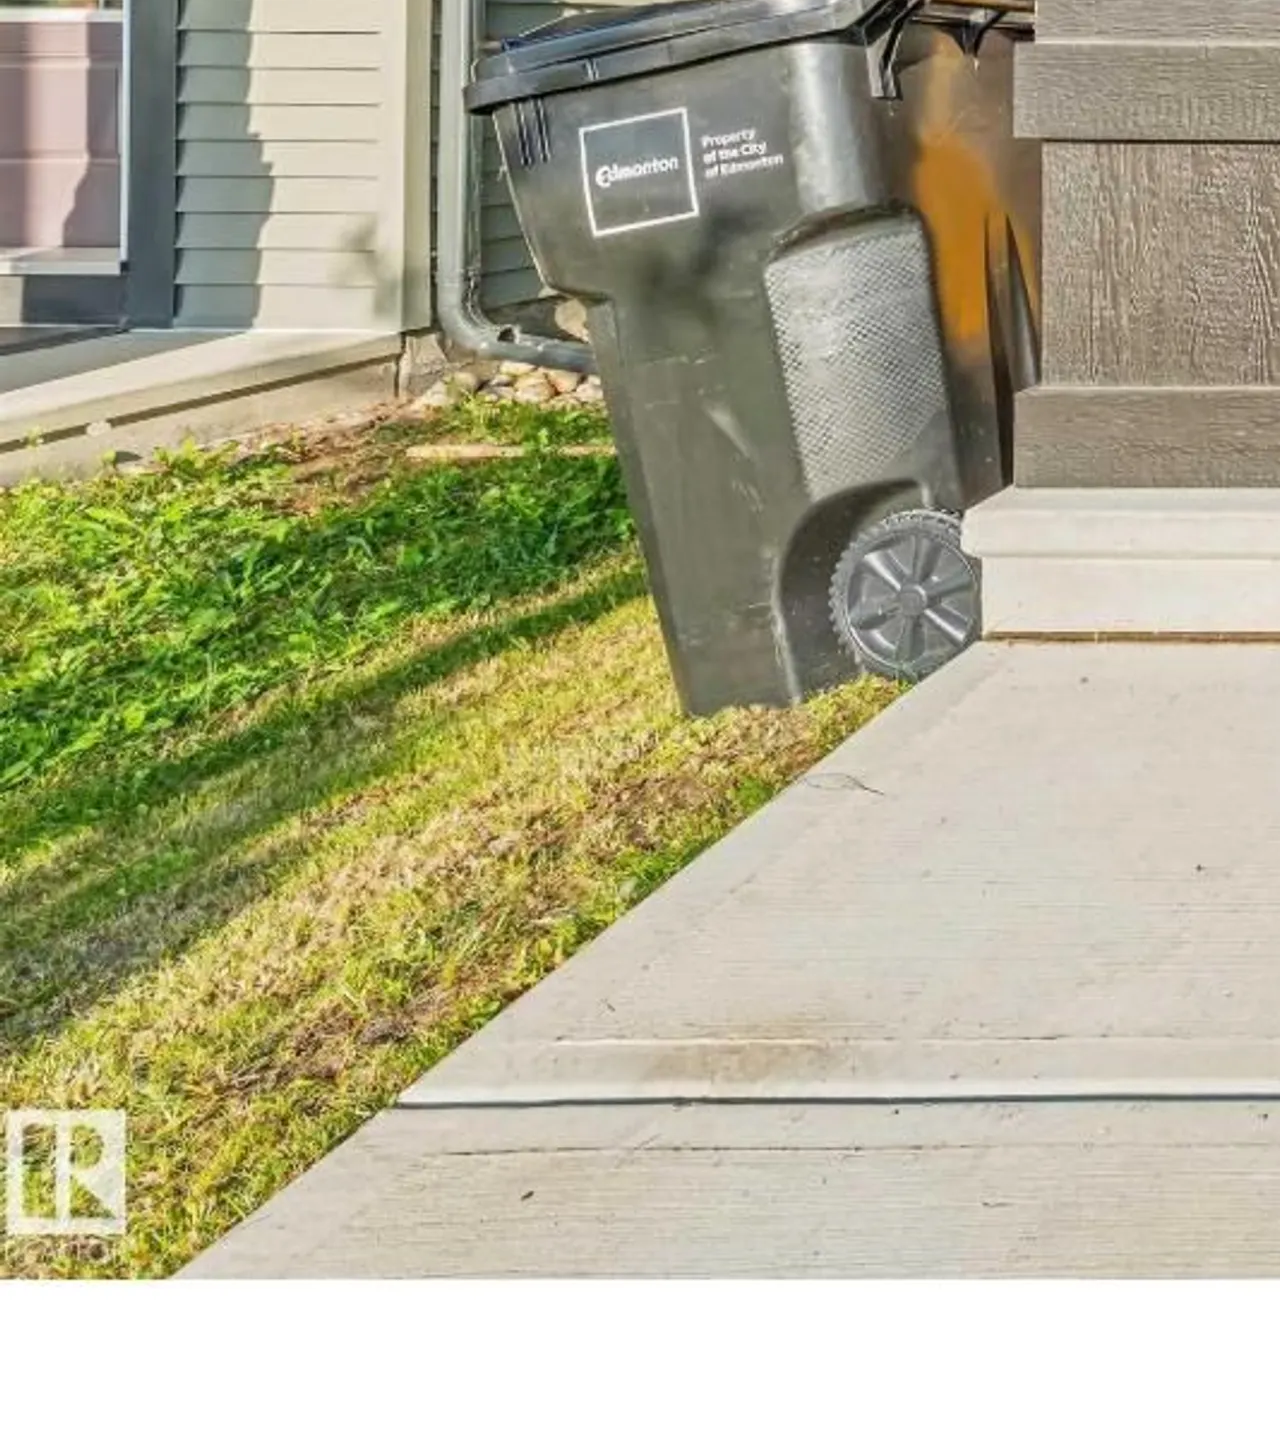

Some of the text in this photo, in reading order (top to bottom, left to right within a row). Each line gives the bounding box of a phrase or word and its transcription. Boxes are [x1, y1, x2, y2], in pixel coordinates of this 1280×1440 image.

[702, 127, 756, 147] Property
[703, 142, 767, 164] of the City
[706, 154, 783, 178] of Edmonton
